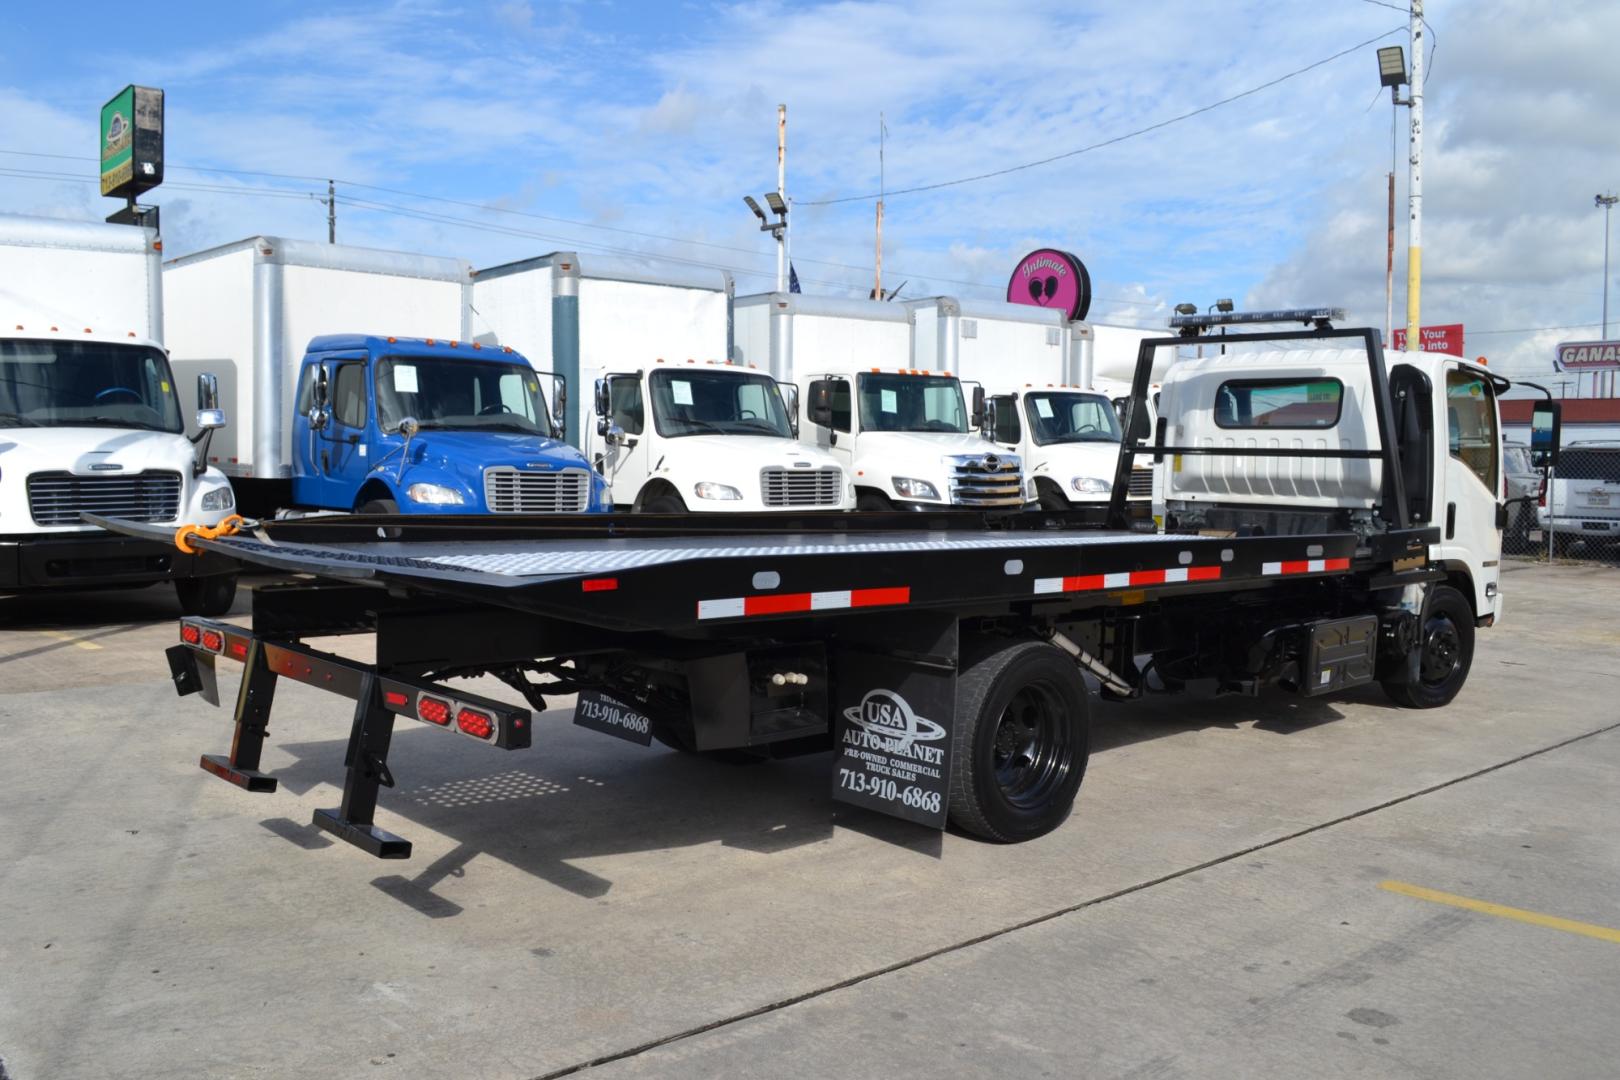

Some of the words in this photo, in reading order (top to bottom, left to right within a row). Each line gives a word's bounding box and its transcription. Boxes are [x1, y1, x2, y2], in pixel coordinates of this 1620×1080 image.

[1022, 257, 1066, 277] Intimate
[1422, 330, 1446, 339] Your
[1427, 340, 1448, 350] into
[582, 699, 649, 734] 713-910-6868
[866, 701, 905, 728] USA
[844, 748, 887, 765] PRE-OWNED
[889, 759, 941, 778] COMMERCIAL
[865, 761, 891, 776] TRUCK
[891, 768, 917, 782] SALES
[839, 768, 941, 813] 713-910-6868
